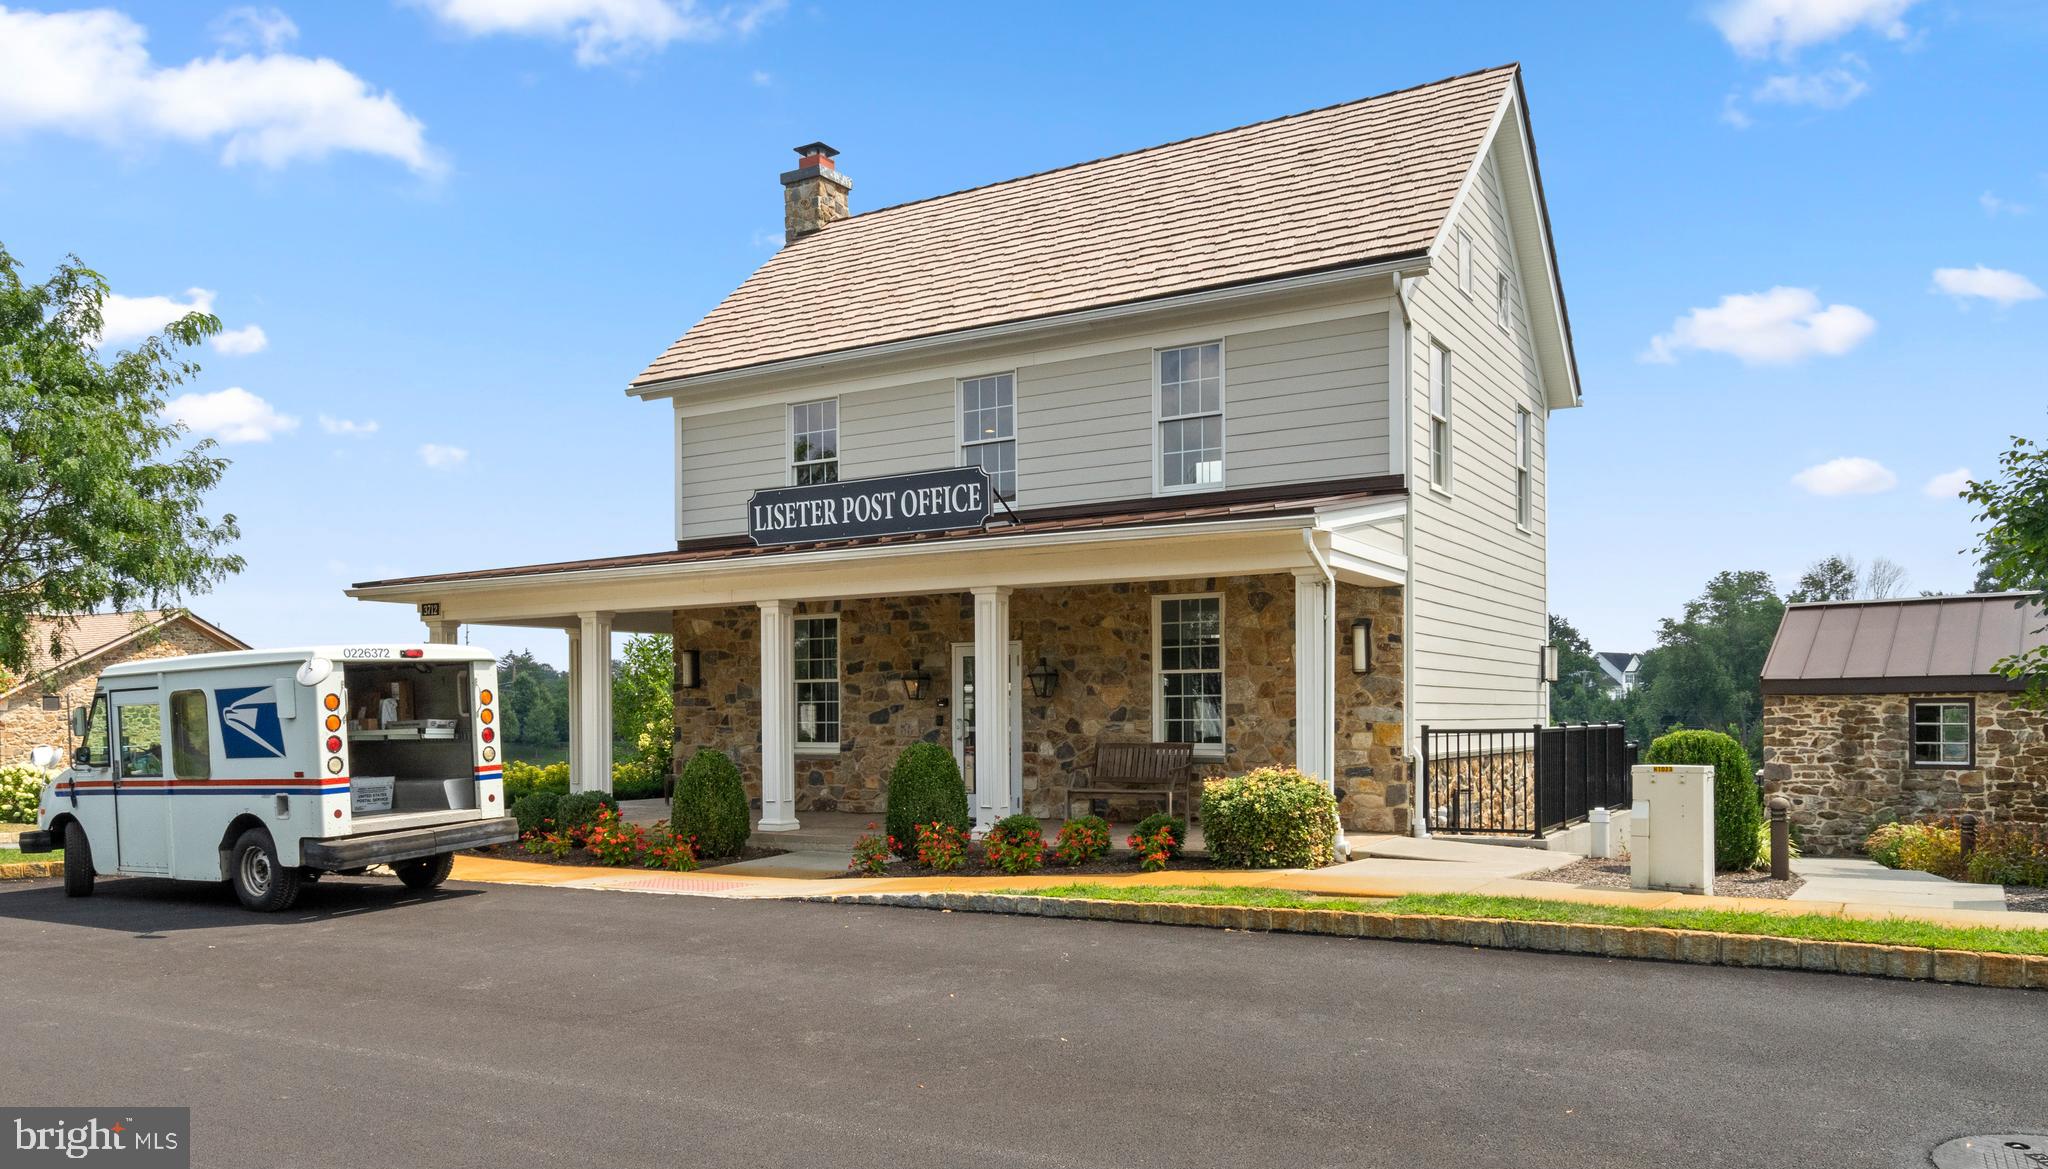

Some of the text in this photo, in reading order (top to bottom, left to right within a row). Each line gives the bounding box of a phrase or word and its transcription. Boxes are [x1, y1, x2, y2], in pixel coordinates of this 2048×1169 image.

[754, 483, 982, 532] LISETER POST OFFICE
[423, 604, 438, 615] 3712
[343, 648, 390, 658] 0226372
